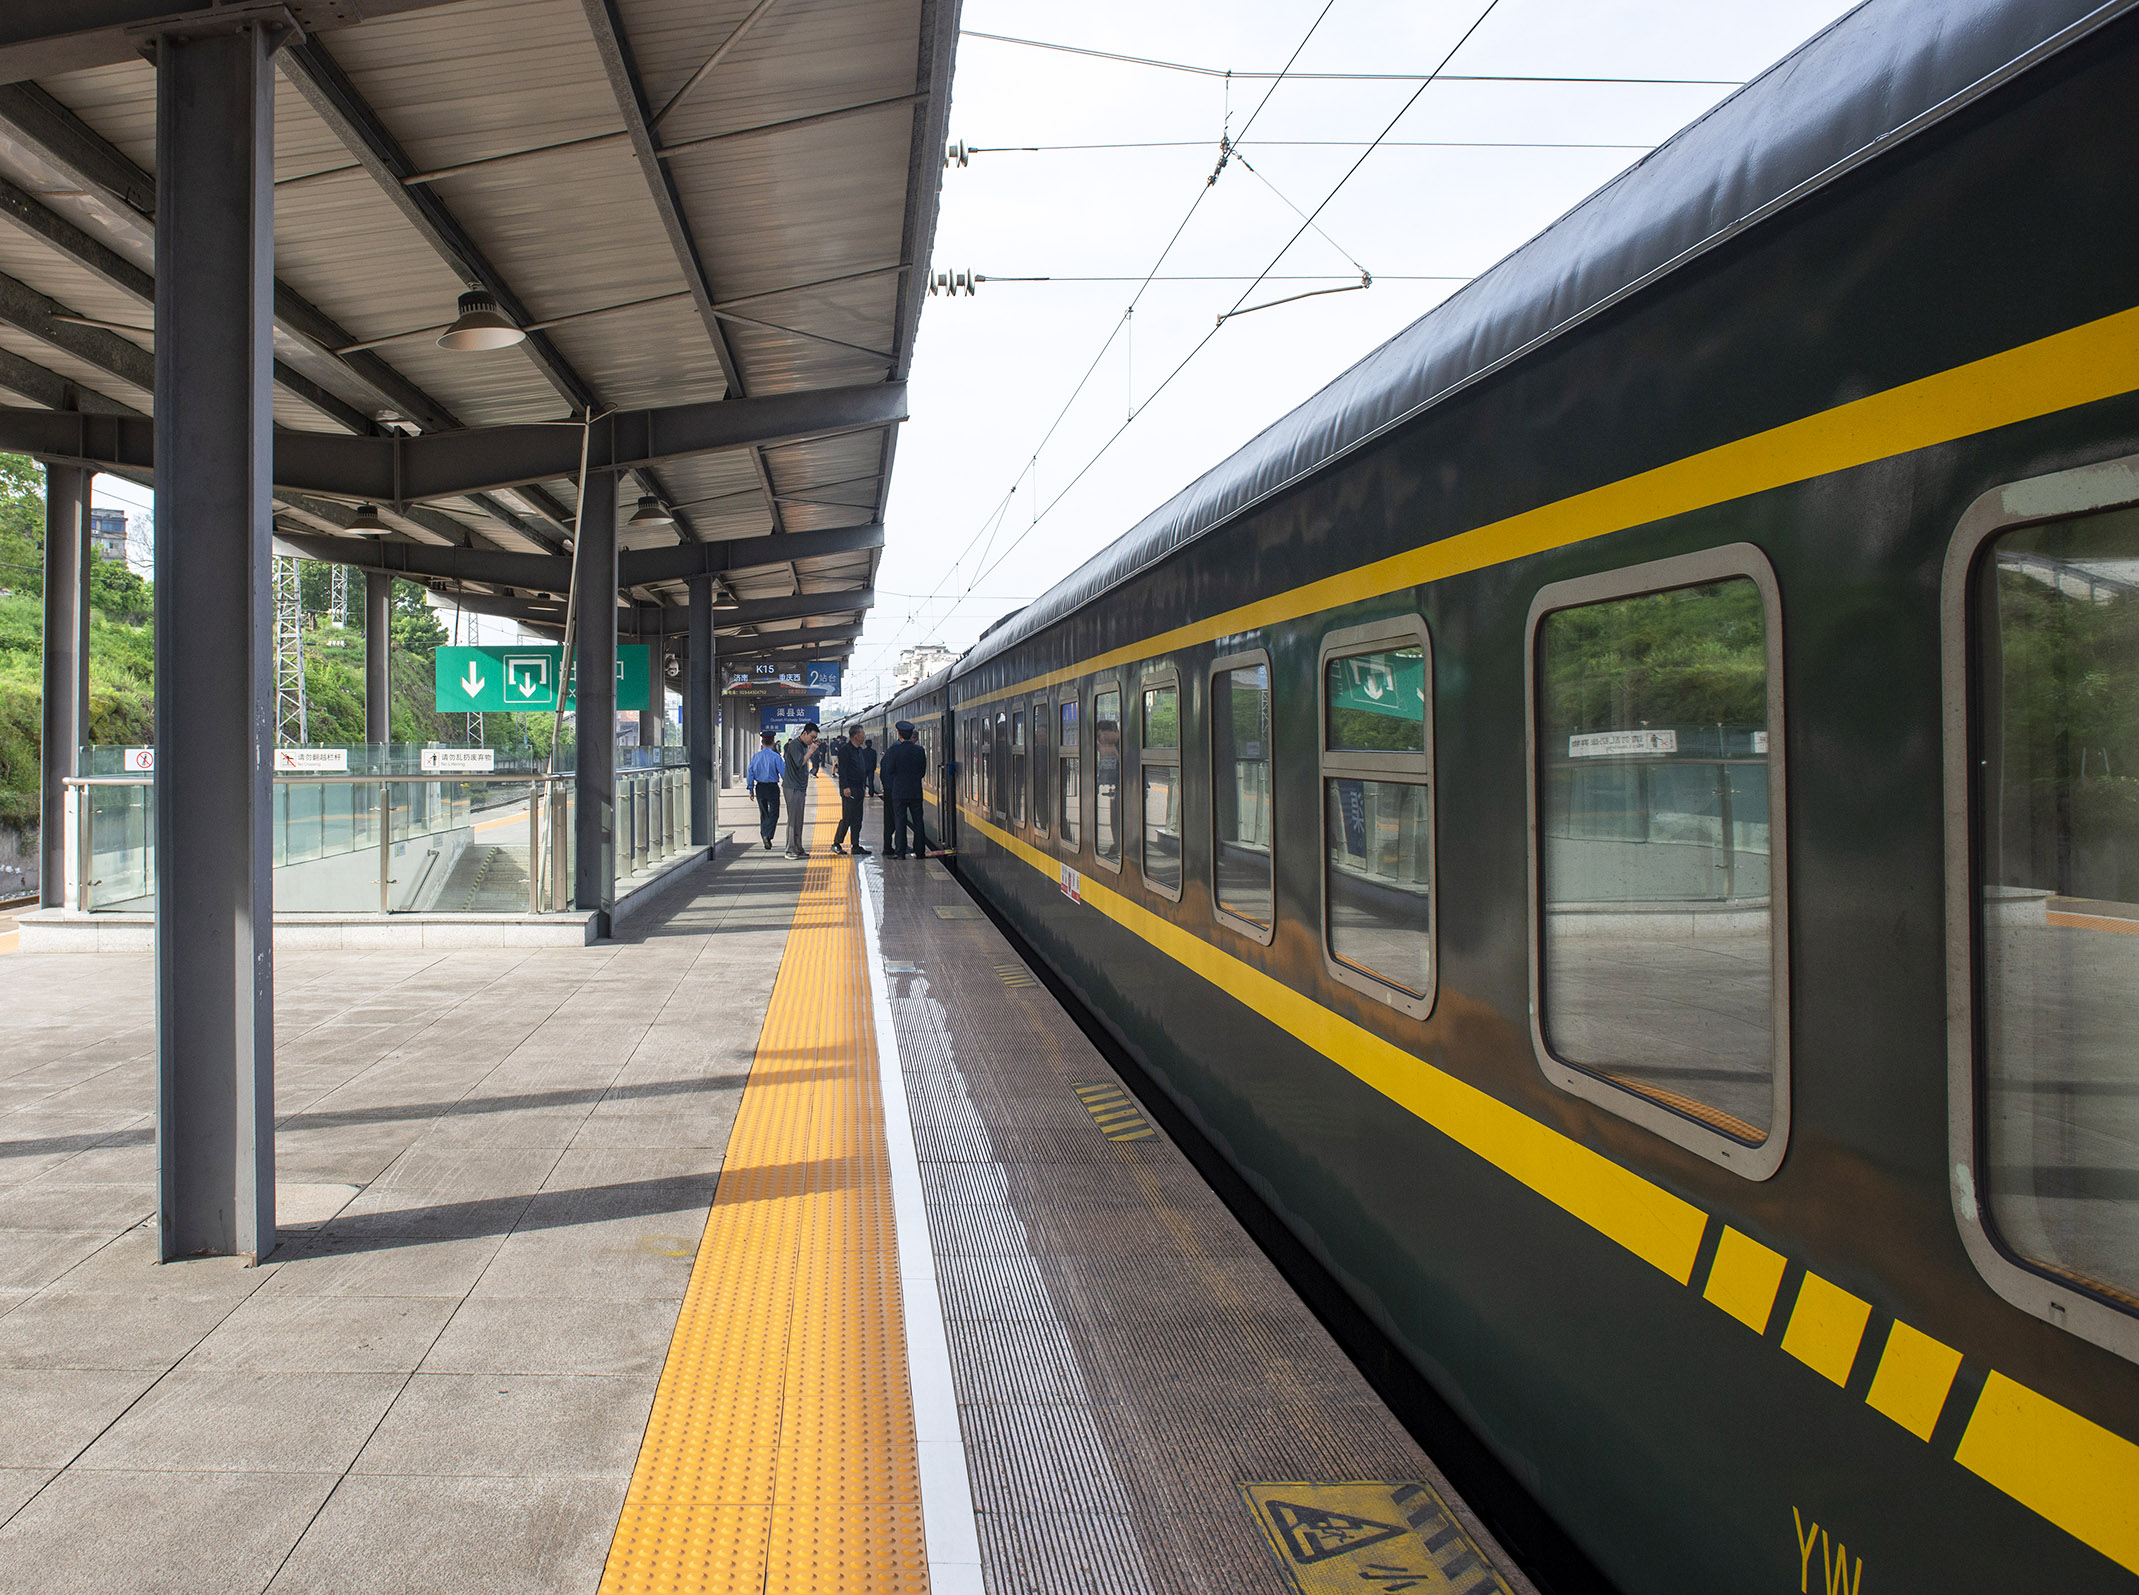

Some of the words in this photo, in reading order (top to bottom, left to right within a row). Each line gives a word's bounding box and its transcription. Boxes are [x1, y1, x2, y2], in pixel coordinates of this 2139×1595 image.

[756, 664, 775, 674] K15
[733, 673, 749, 682] 济南
[778, 673, 801, 682] 重庆西
[776, 707, 806, 717] 渠县站
[297, 753, 342, 761] 请勿翻越栏杆
[441, 753, 492, 761] 请勿乱扔废弃物
[1792, 1505, 1863, 1595] YW
